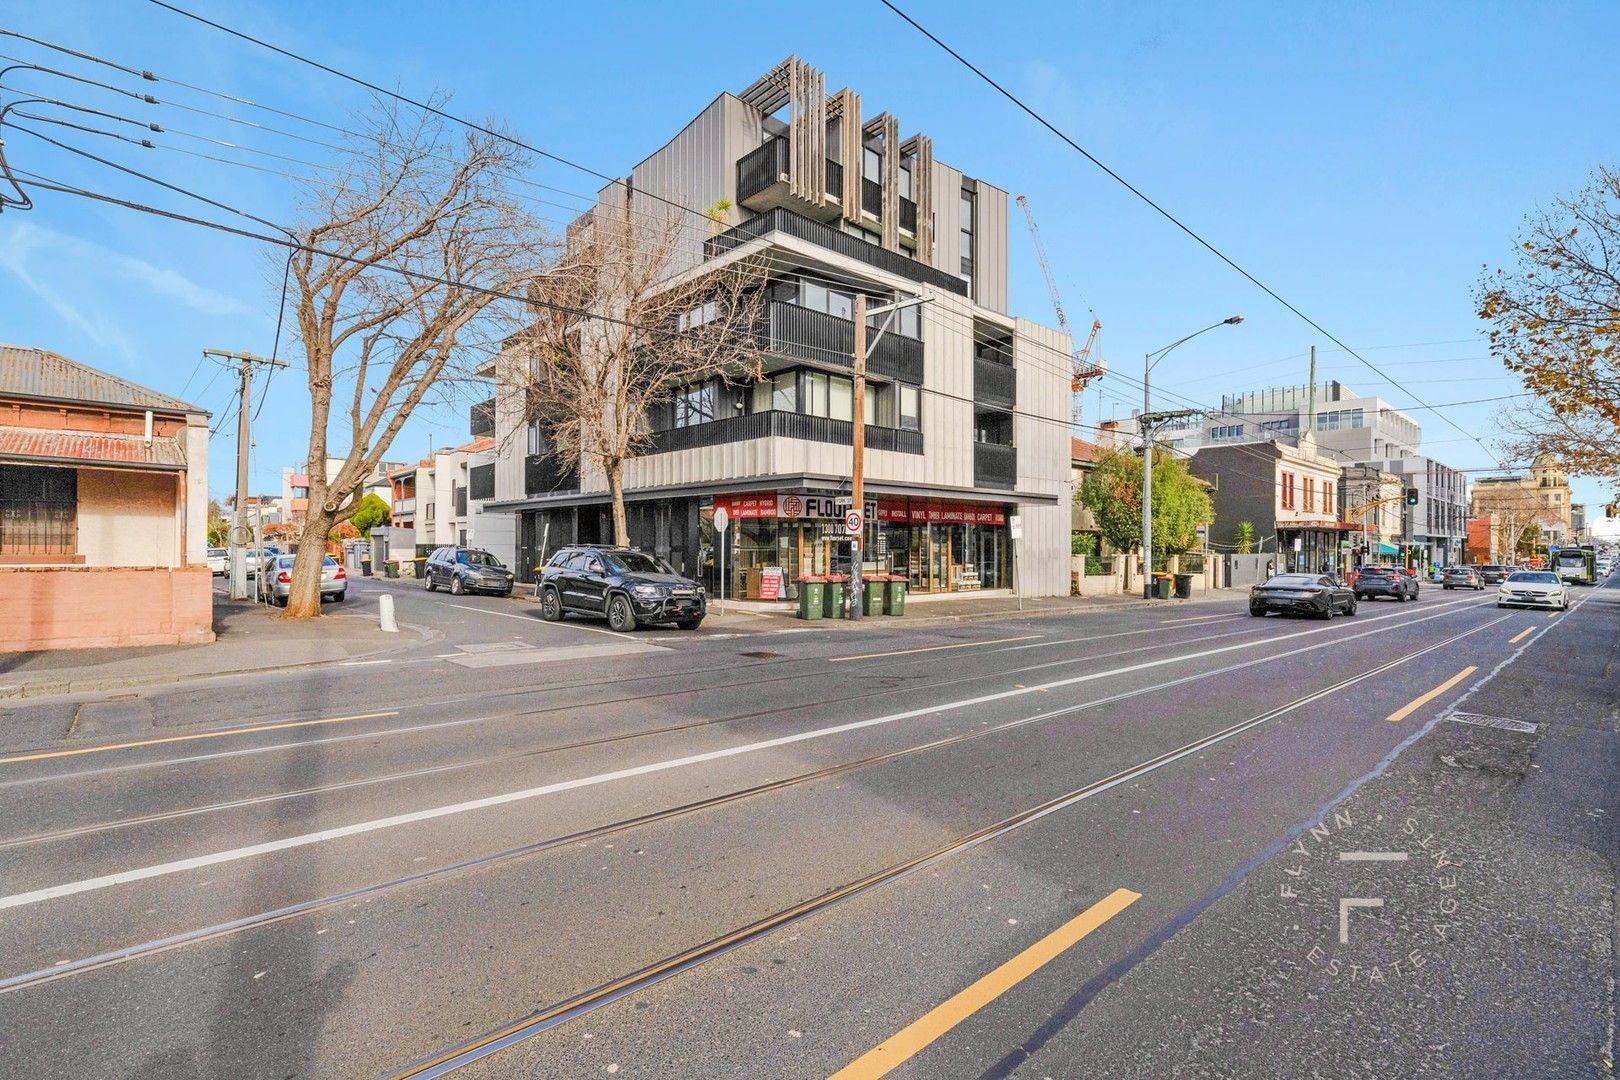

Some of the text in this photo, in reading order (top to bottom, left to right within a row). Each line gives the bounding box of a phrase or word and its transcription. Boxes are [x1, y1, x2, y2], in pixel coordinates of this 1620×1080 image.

[911, 510, 926, 520] VINYL
[976, 512, 993, 521] CARPET
[848, 517, 859, 527] 40
